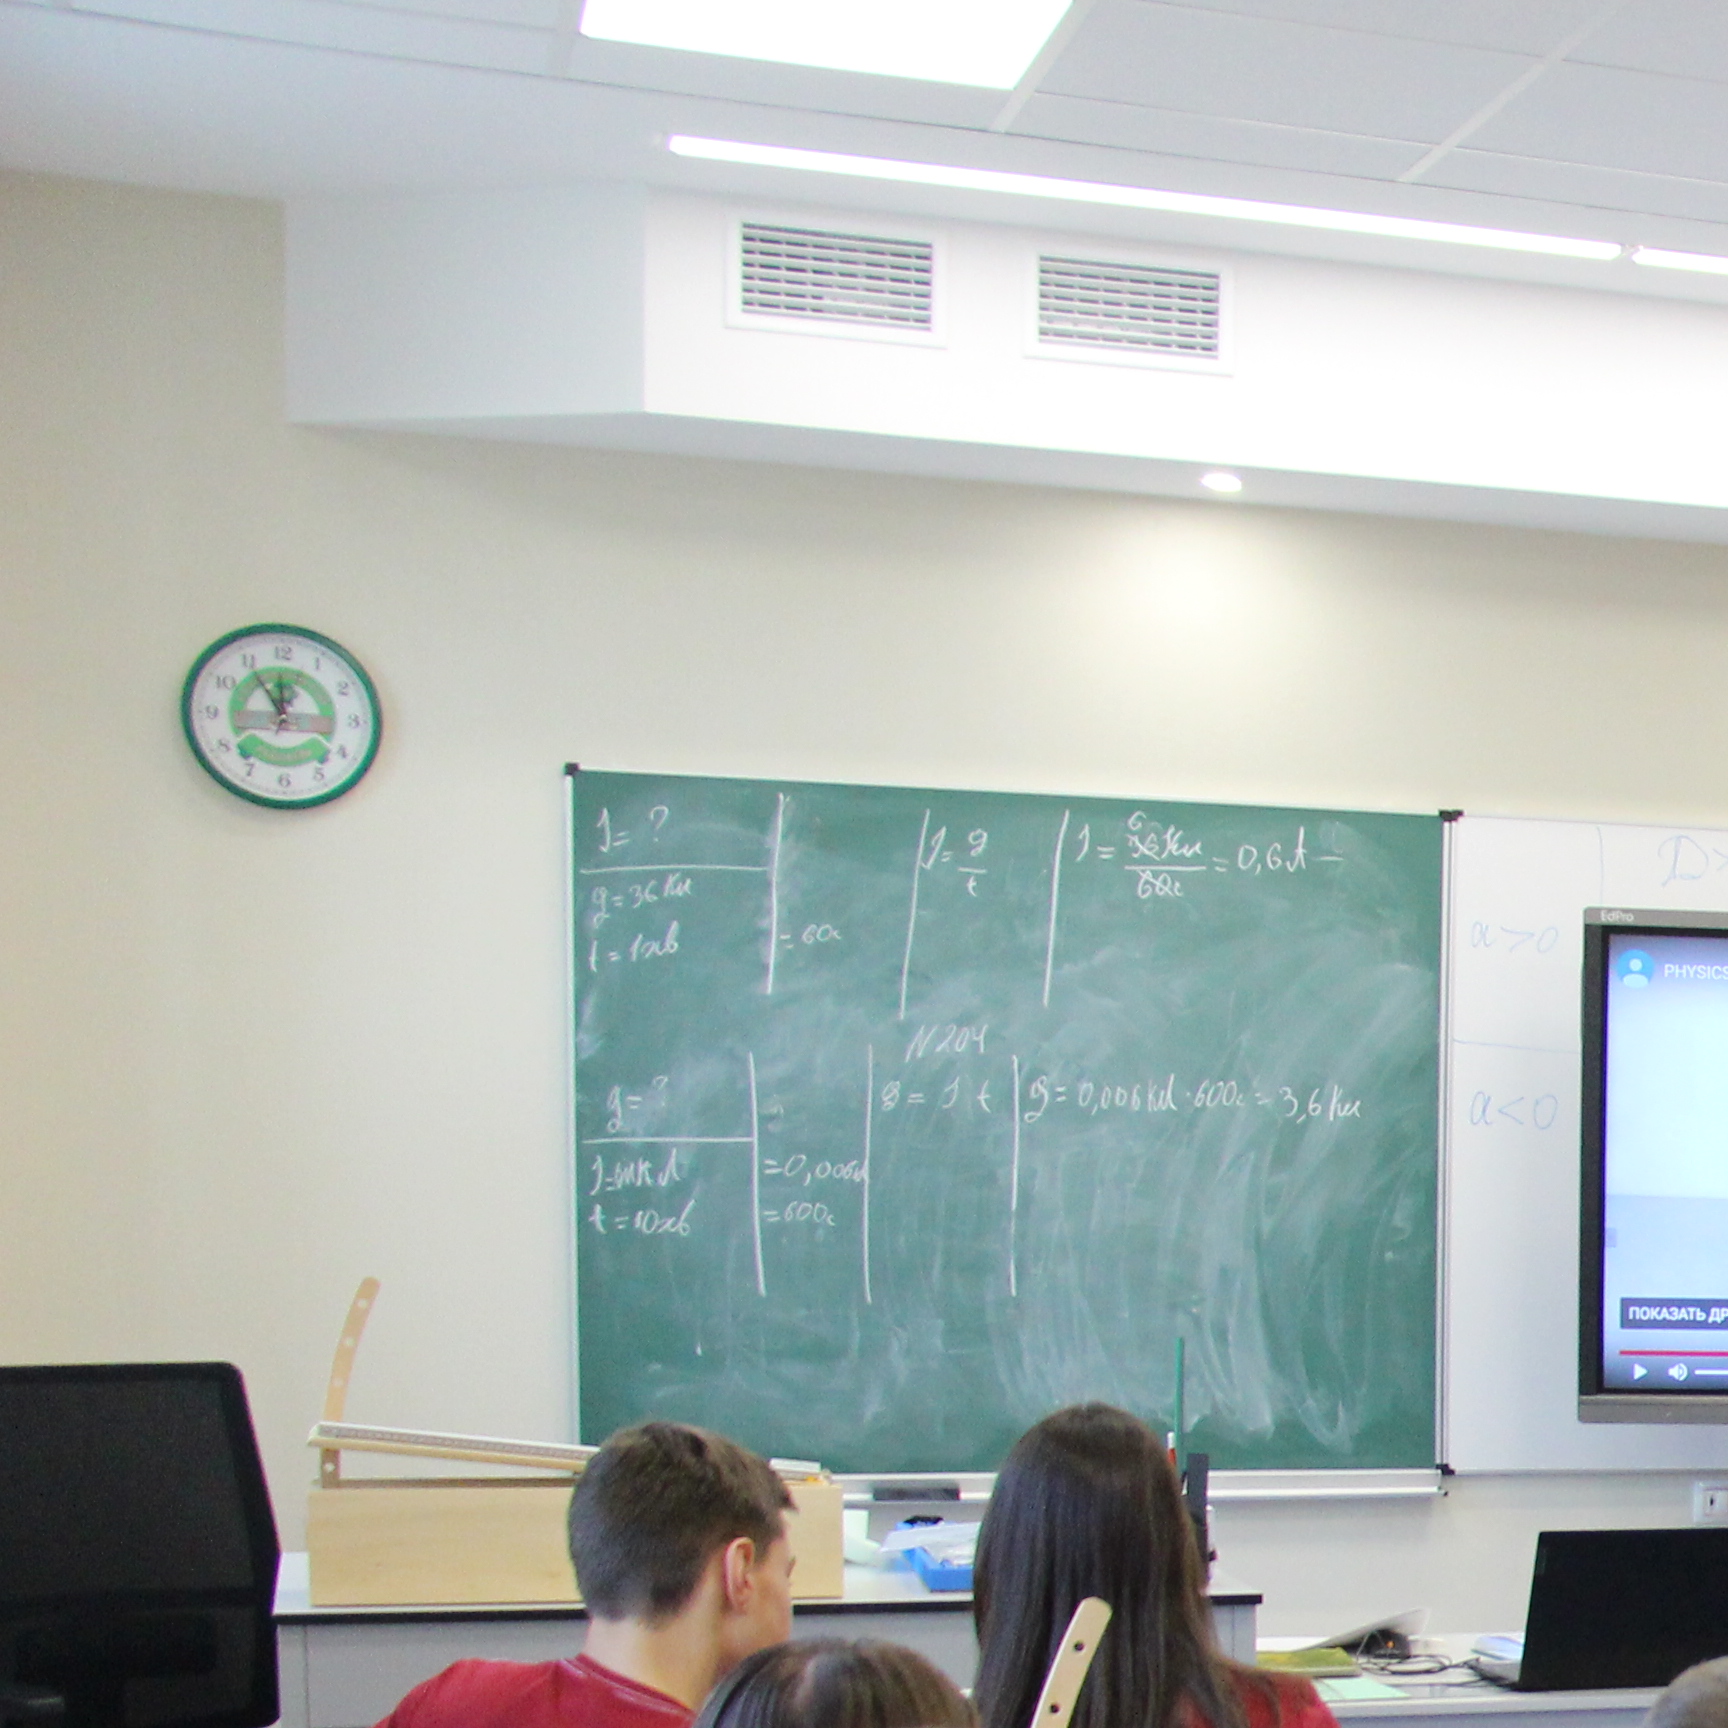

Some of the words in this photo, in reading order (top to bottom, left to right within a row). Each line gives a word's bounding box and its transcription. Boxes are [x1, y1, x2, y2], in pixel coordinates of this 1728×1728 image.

[275, 646, 292, 661] 12
[242, 654, 256, 669] 11
[314, 658, 321, 671] 1
[216, 675, 236, 689] 10
[337, 681, 349, 696] 2
[206, 705, 219, 719] 9
[348, 714, 360, 728] 3
[218, 739, 231, 752] 8
[338, 745, 348, 759] 4
[245, 763, 255, 777] 7
[314, 767, 325, 781] 5
[278, 773, 291, 788] 6
[1628, 1306, 1706, 1321] ПОКАЗАТЬ
